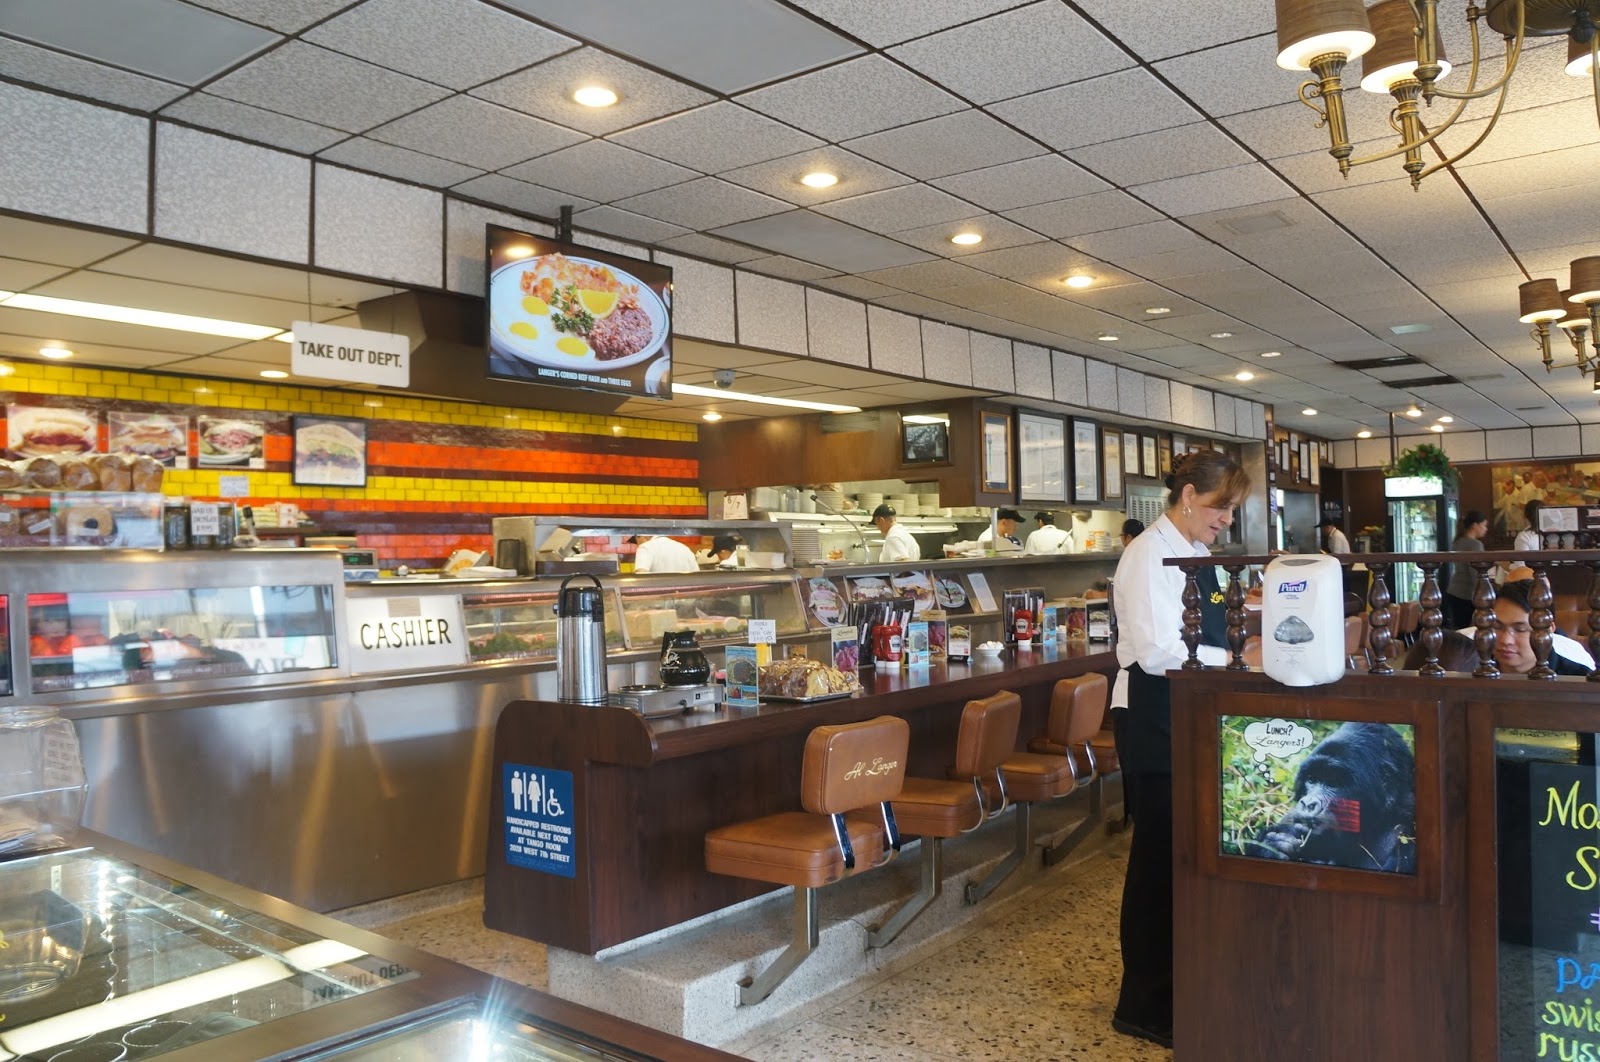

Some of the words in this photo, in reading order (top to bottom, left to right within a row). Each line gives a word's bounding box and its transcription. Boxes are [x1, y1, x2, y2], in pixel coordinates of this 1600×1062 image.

[299, 341, 334, 359] TAKE
[338, 346, 364, 363] OUT
[368, 350, 402, 368] DEPT.
[538, 367, 560, 378] LANGER'S
[560, 370, 578, 380] CORNED
[578, 373, 588, 381] BEEF
[588, 375, 600, 383] HASH
[607, 377, 621, 386] THREE
[620, 379, 632, 387] EGGS
[360, 618, 452, 650] CASHIER
[844, 761, 866, 781] Al
[506, 816, 540, 829] HANDICAPPED
[540, 822, 572, 835] RESTROOMS
[510, 825, 536, 838] AVAILABLE
[537, 831, 552, 840] NEXT
[553, 834, 569, 844] DOOR
[517, 836, 525, 844] AT
[526, 838, 544, 849] TANGO
[545, 842, 562, 852] ROOM
[523, 847, 538, 857] WEST
[549, 852, 570, 863] STREET
